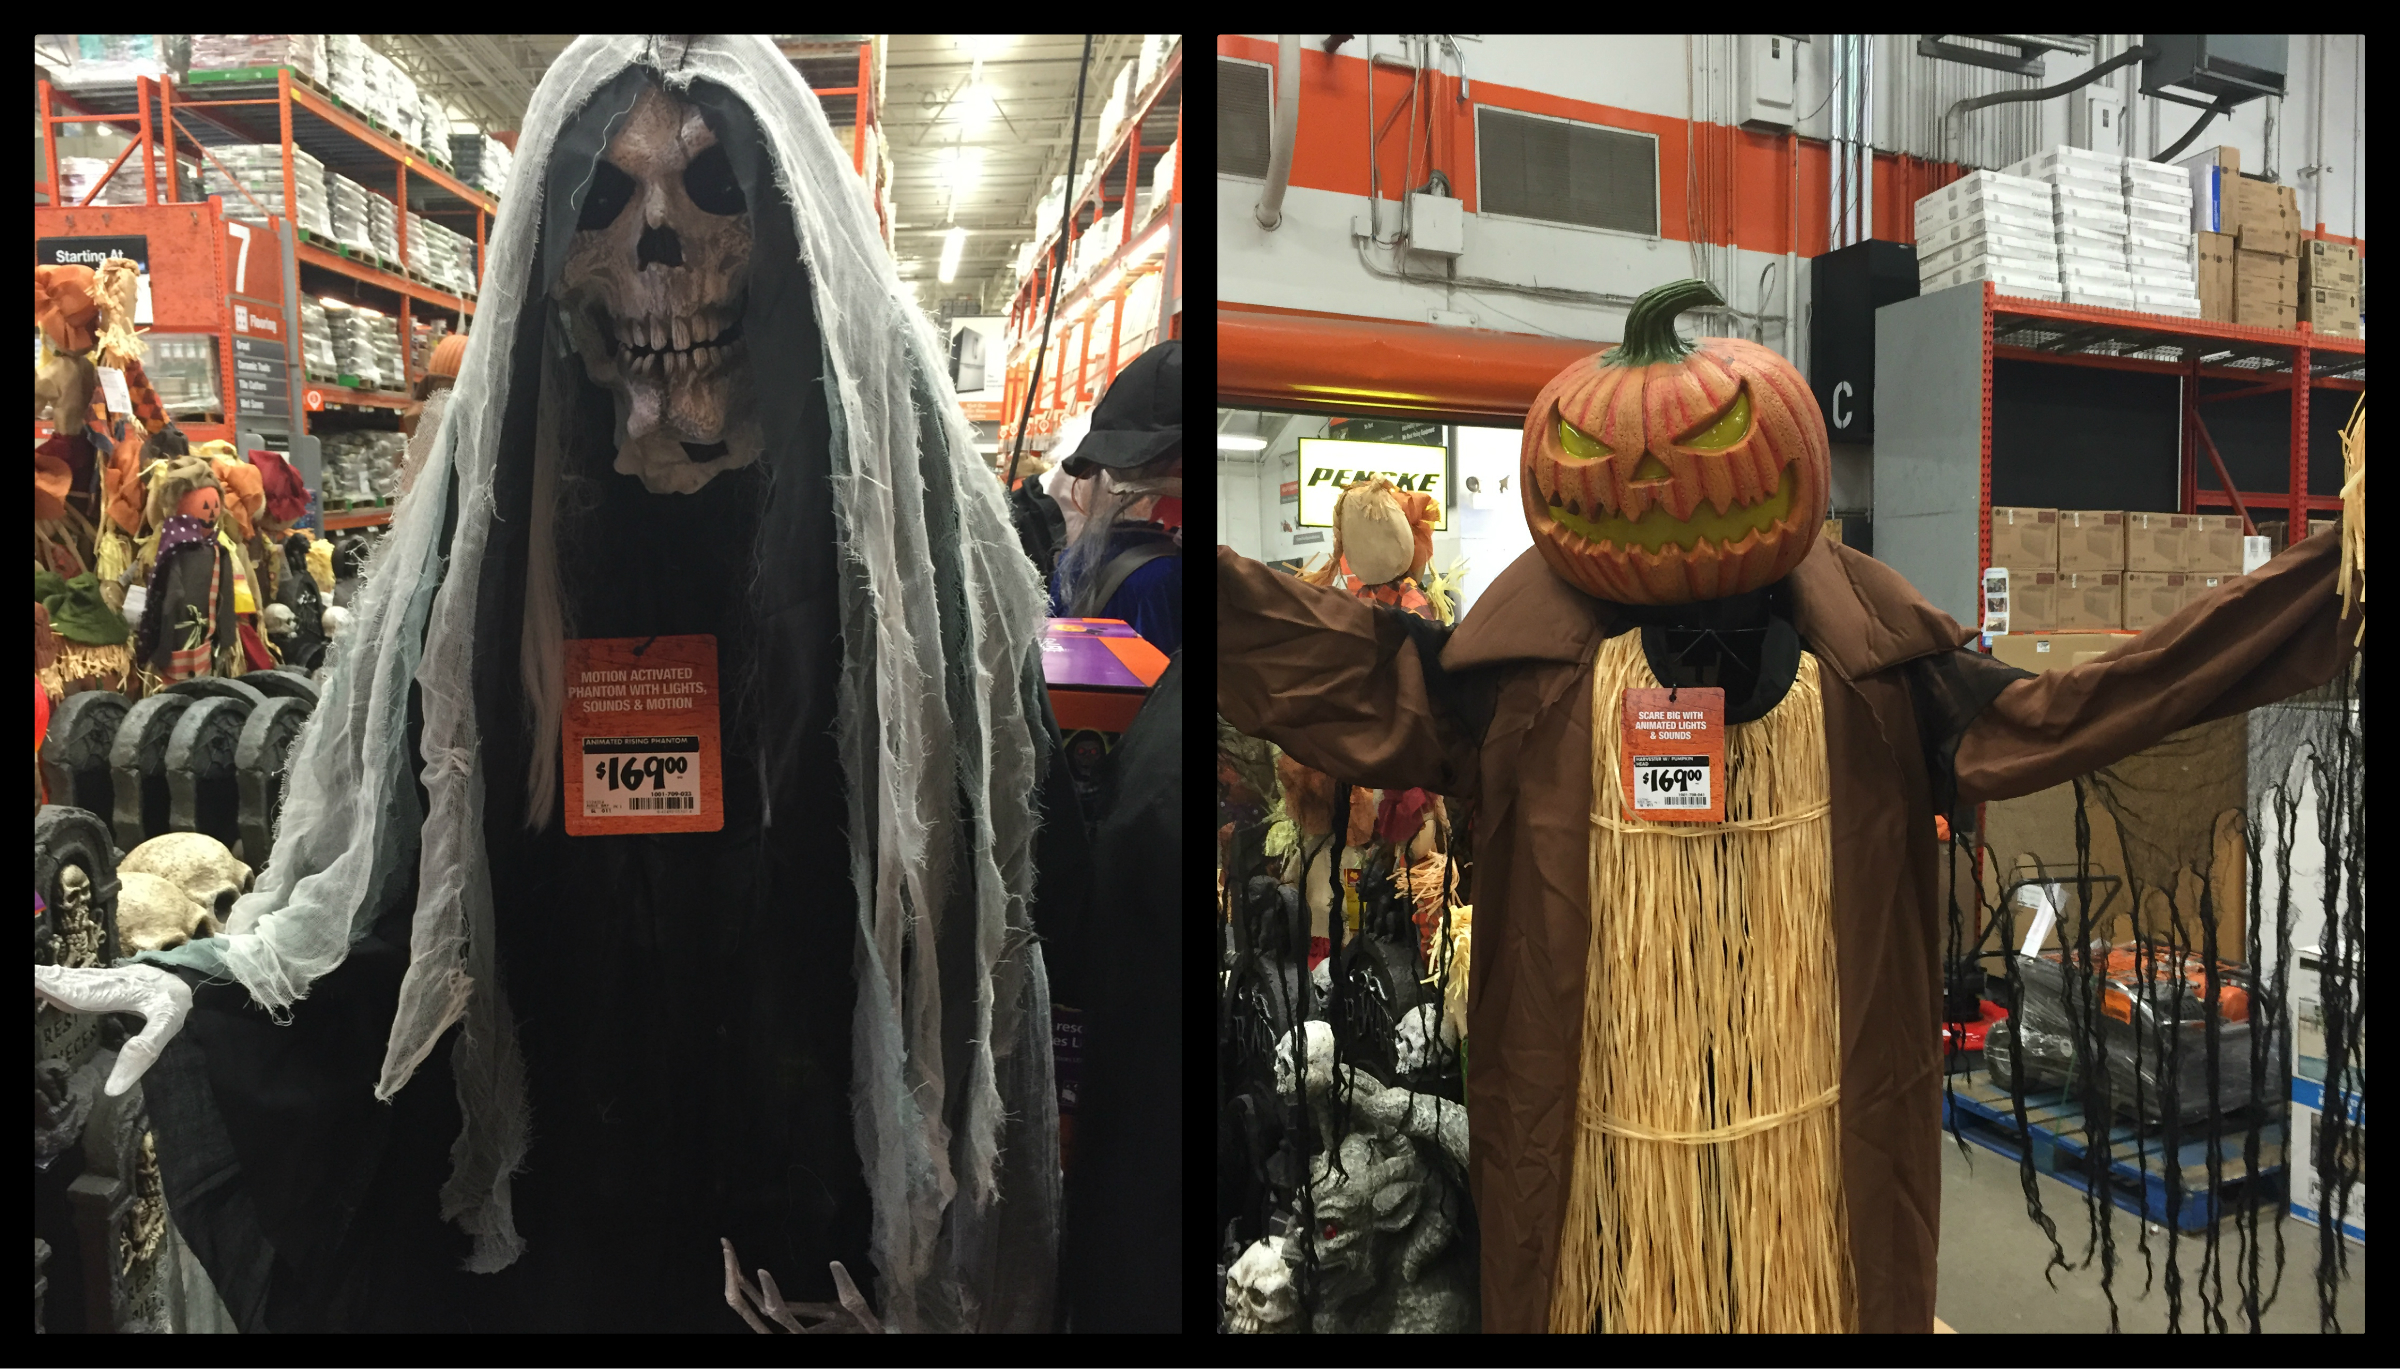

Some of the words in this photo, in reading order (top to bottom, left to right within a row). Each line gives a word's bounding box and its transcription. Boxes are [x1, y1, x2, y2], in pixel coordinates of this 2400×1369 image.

[56, 249, 106, 263] Starting
[229, 222, 251, 293] 7
[1833, 381, 1853, 430] C
[581, 671, 627, 684] MOTION
[629, 667, 693, 681] ACTIVATED
[568, 685, 627, 699] PHANTOM
[629, 683, 660, 697] WITH
[662, 681, 708, 696] LIGHTS,
[582, 700, 631, 713] SOUNDS
[633, 699, 644, 712] &
[646, 697, 693, 711] MOTION
[1638, 711, 1665, 720] SCARE
[1666, 711, 1681, 720] BIG
[1682, 711, 1704, 720] WITH
[1635, 721, 1677, 730] ANIMATED
[1678, 721, 1707, 730] LIGHTS
[586, 738, 623, 746] ANIMATED
[624, 737, 649, 745] RISING
[1649, 731, 1657, 740] &
[1658, 731, 1692, 740] SOUNDS
